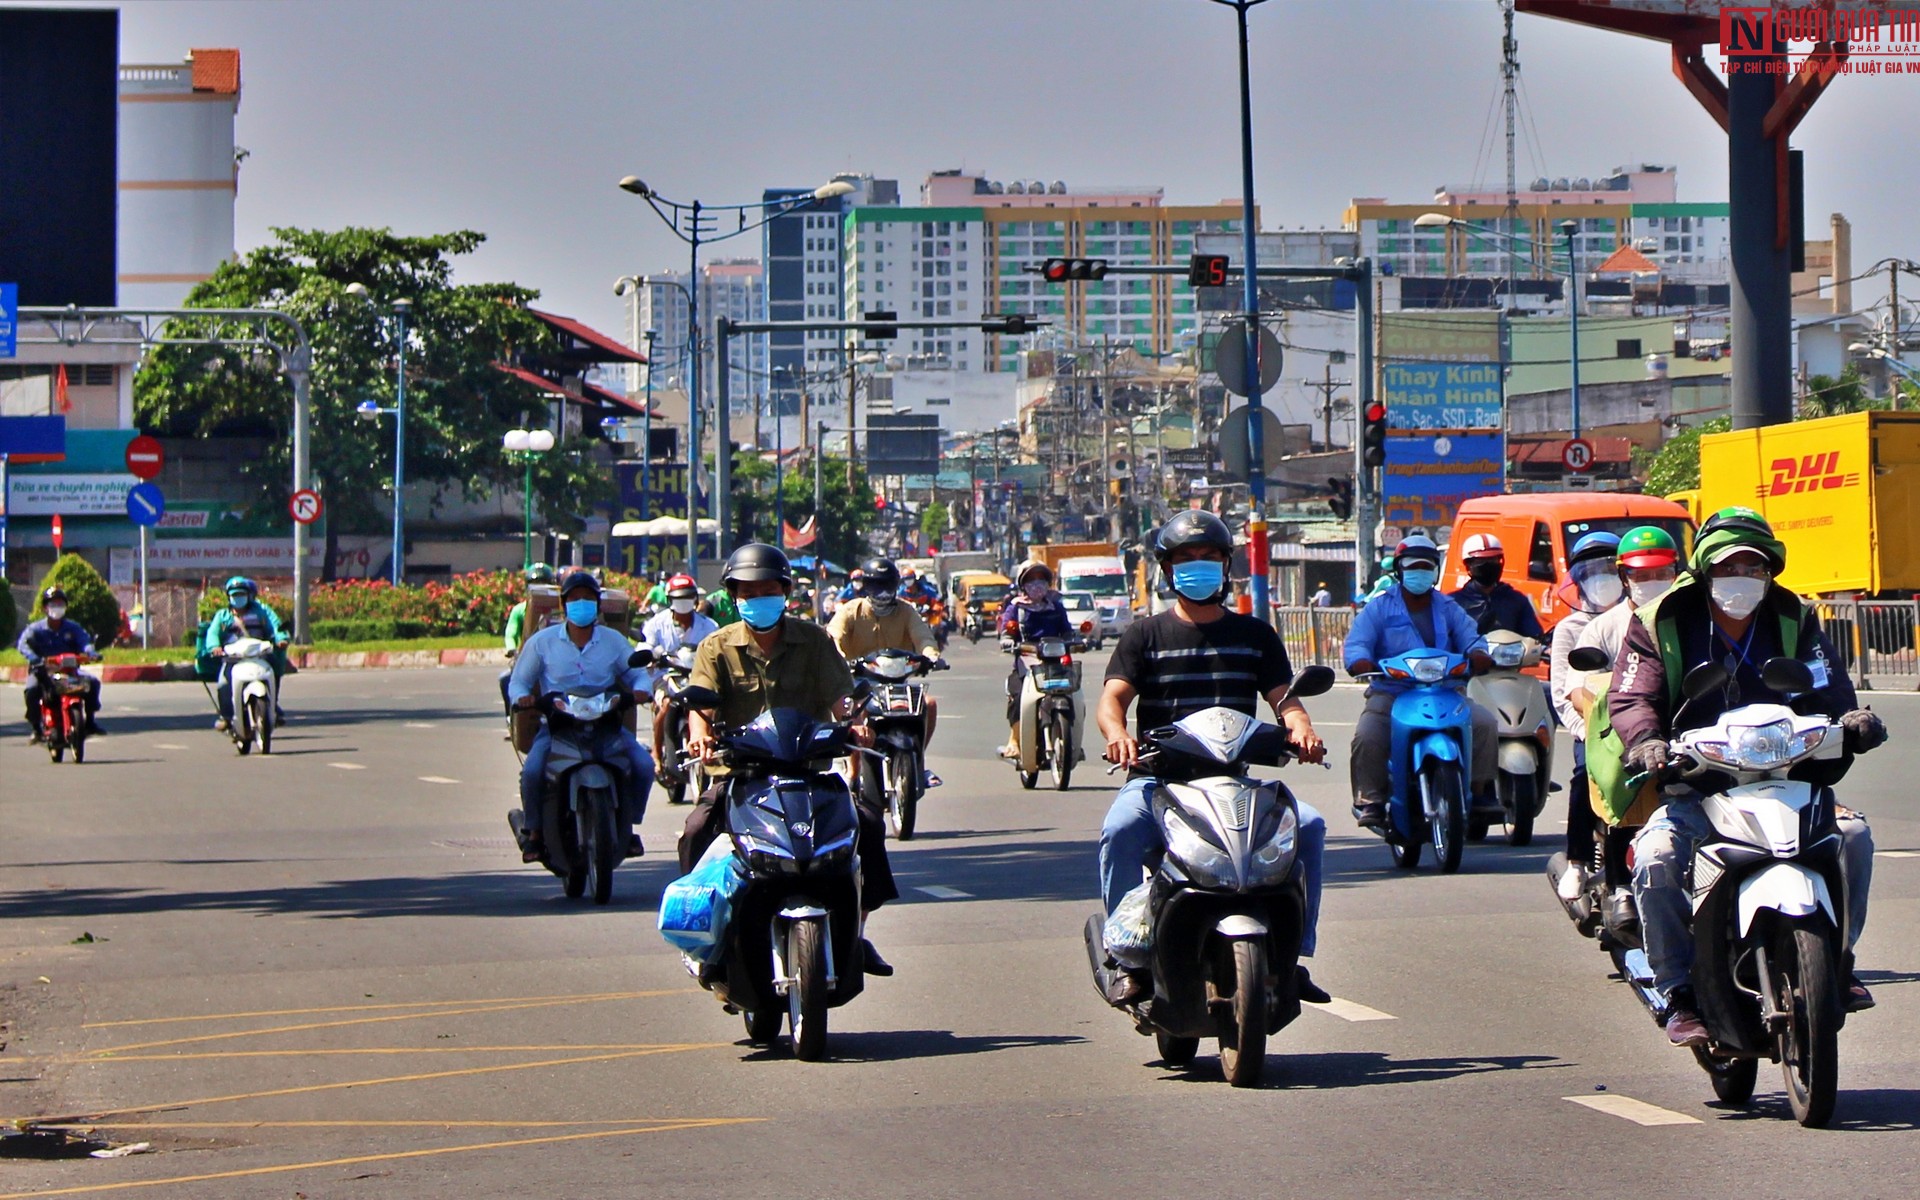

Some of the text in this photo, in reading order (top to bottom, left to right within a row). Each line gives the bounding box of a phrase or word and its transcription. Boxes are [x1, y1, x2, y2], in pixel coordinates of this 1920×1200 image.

[1209, 258, 1224, 285] 5
[1387, 364, 1498, 389] Thay Kính
[1387, 386, 1499, 406] Màn Hình
[1442, 408, 1466, 429] SSD
[1770, 451, 1846, 496] DHL
[177, 547, 201, 558] THAY
[1618, 652, 1641, 693] gojek
